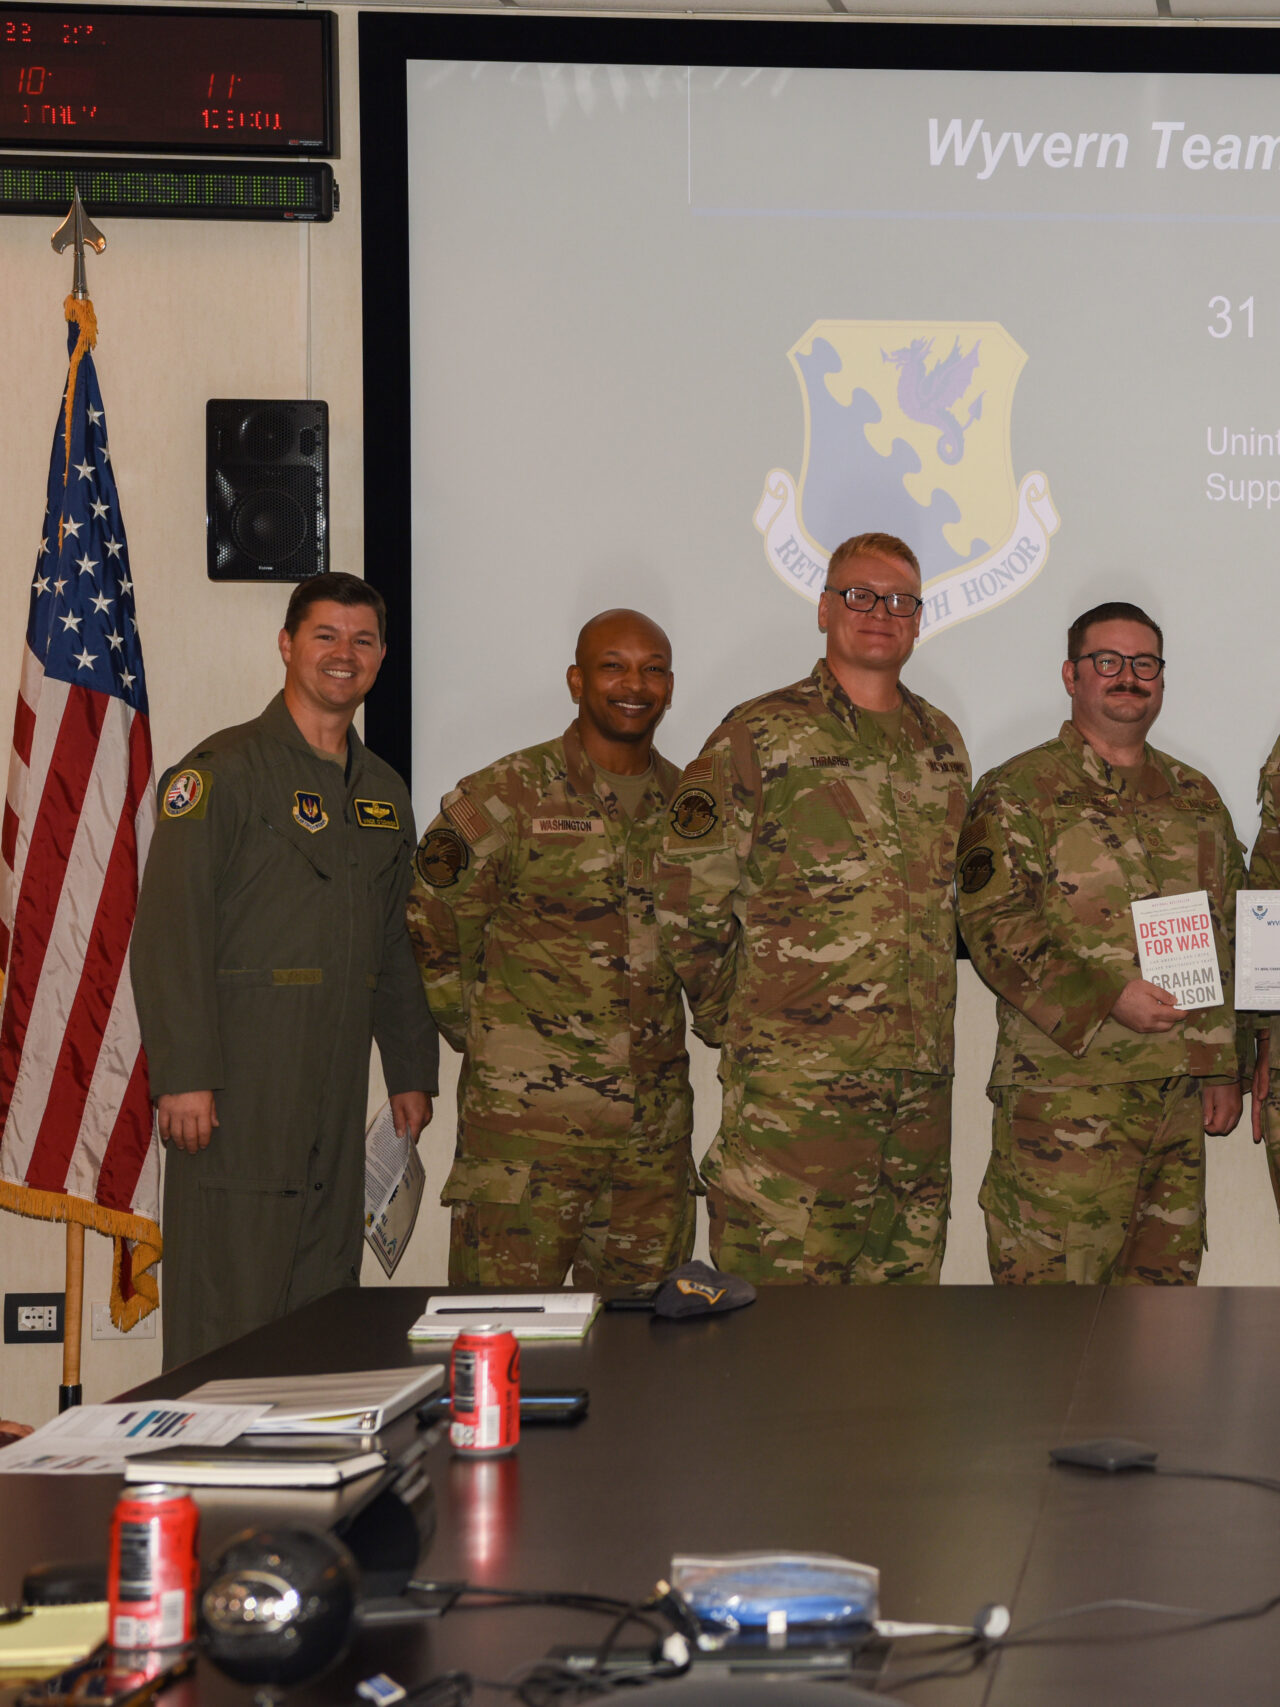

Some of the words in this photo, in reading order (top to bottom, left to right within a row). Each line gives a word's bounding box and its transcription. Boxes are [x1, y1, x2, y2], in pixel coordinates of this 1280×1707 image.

[928, 118, 1129, 180] Wyvern
[1207, 295, 1254, 339] 31
[774, 534, 826, 589] RET
[920, 589, 952, 629] TH
[960, 535, 1041, 607] HONOR
[539, 820, 592, 832] WASHINGTON
[1139, 913, 1210, 939] DESTINED
[1145, 938, 1174, 957] FOR
[1176, 932, 1210, 952] WAR
[1151, 966, 1215, 989] GRAHAM
